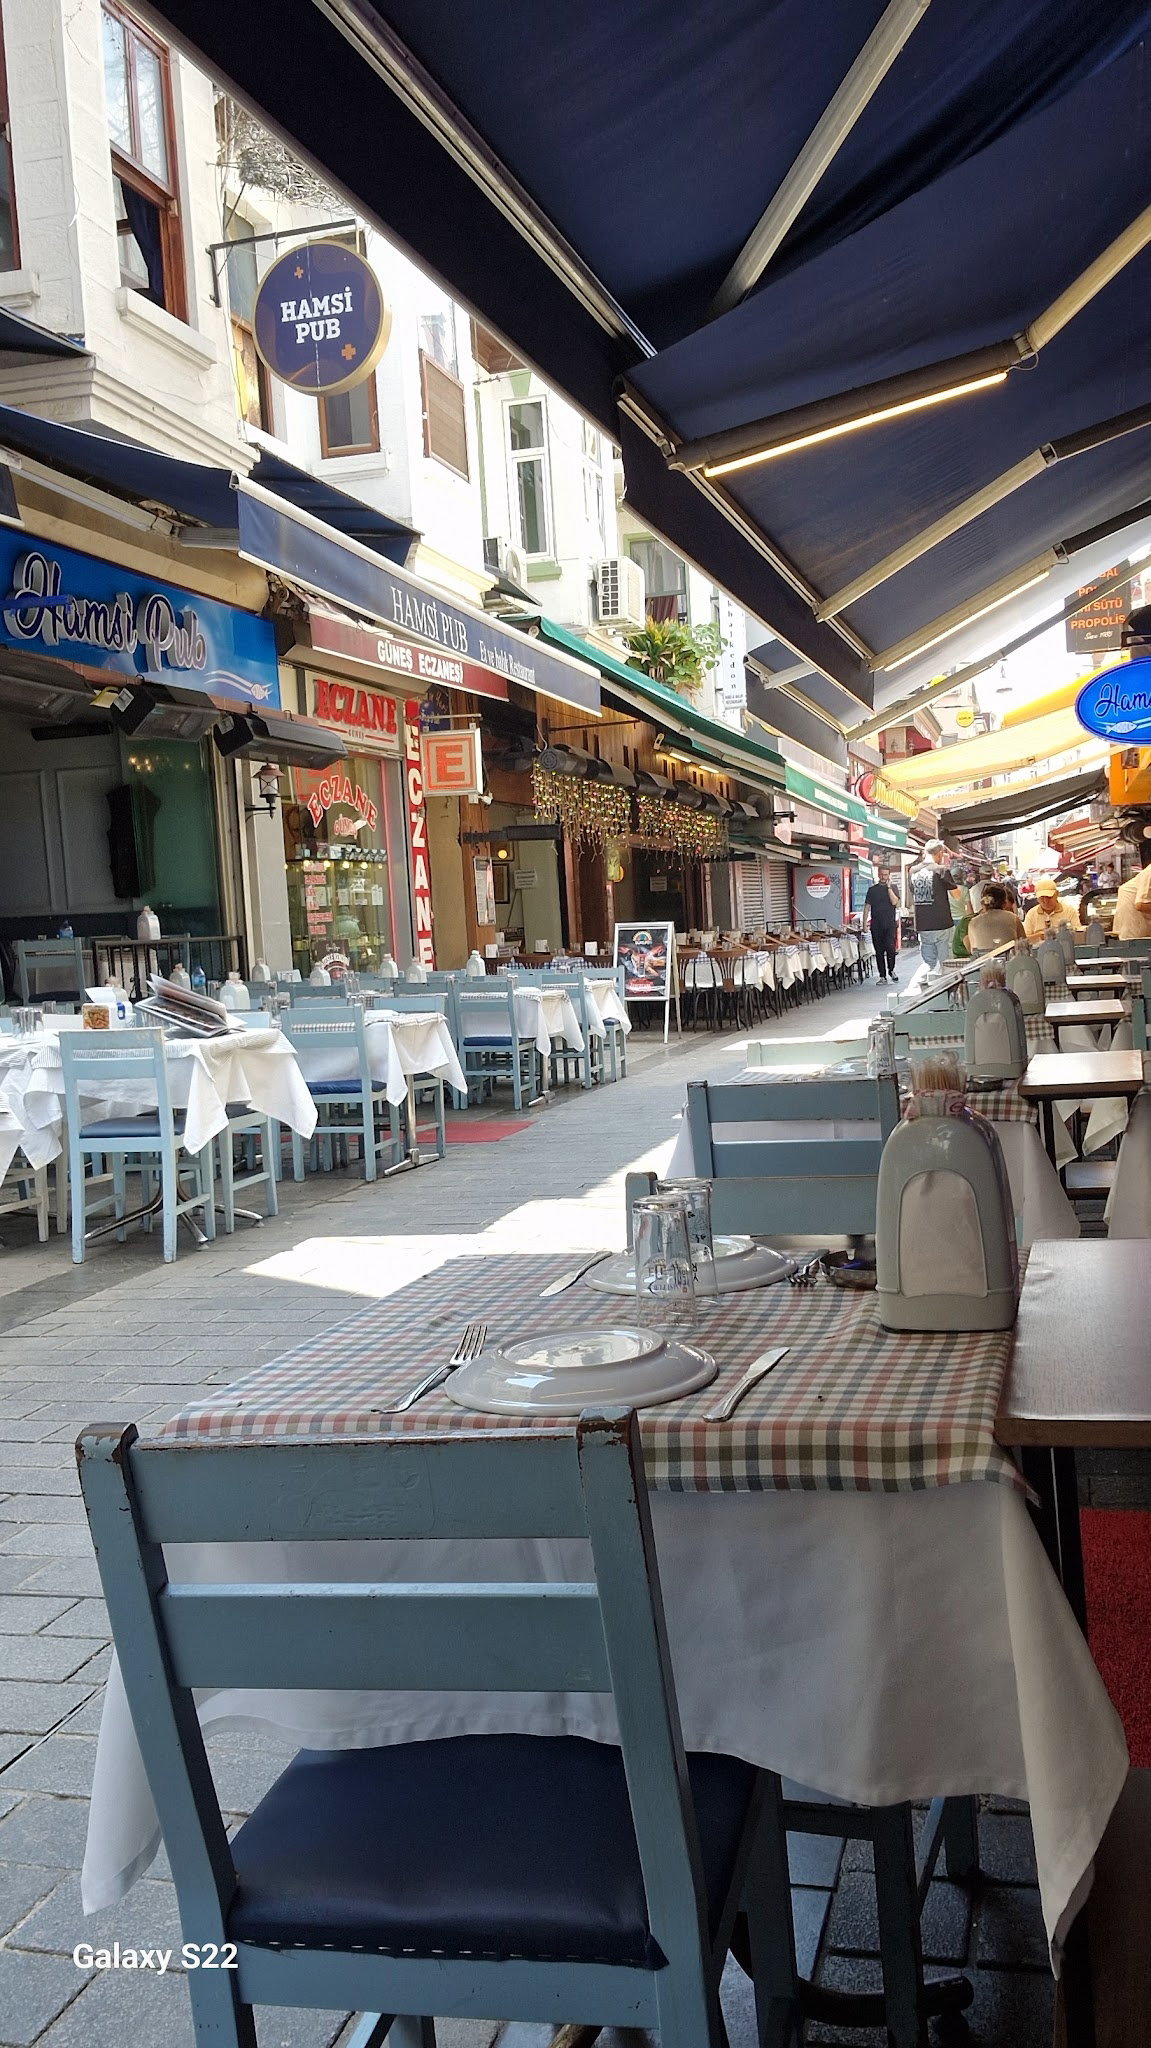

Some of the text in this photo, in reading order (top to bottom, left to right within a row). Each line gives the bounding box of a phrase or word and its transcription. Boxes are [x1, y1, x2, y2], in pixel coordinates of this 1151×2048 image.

[280, 286, 353, 322] HAMSİ
[295, 318, 340, 344] PUB
[6, 552, 208, 672] Hamsi Pub
[391, 586, 440, 641] HAMSİ
[441, 613, 468, 653] PUB
[1071, 614, 1127, 630] PROPOLİS
[1093, 597, 1123, 611] SÜTÜ
[378, 639, 464, 684] GÜNEŞ ECZANESİ
[316, 680, 397, 735] ECZANE
[1094, 683, 1151, 718] Ham
[436, 744, 466, 783] E
[307, 775, 378, 832] ECZANE
[406, 723, 435, 971] ECZANE
